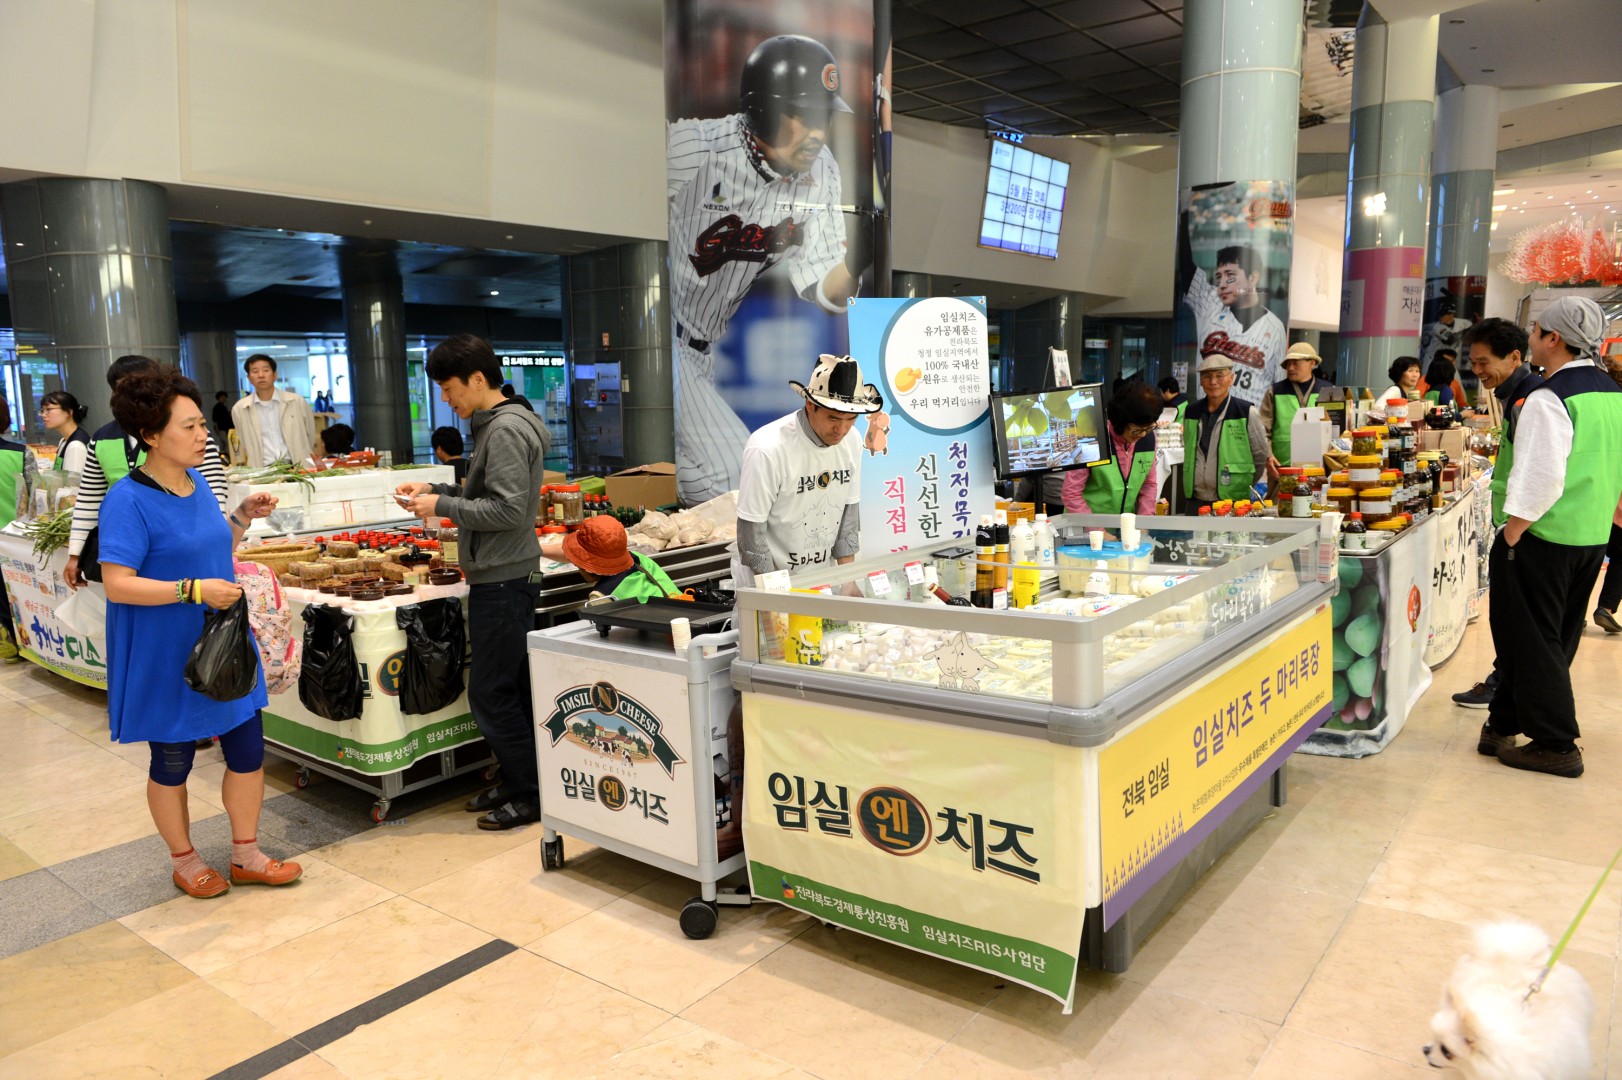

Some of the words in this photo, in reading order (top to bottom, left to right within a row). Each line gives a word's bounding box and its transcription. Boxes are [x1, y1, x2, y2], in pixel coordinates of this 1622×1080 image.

[703, 203, 730, 212] NEXON
[940, 312, 977, 323] 임실치즈
[924, 325, 978, 337] 유가공제품은
[918, 348, 932, 358] 청정
[935, 347, 978, 358] 임실지역에서
[949, 337, 978, 347] 전라북도
[1203, 331, 1266, 369] Giants
[925, 361, 949, 370] 100%
[951, 359, 979, 370] 국내산
[923, 373, 949, 385] 원유로
[951, 374, 980, 384] 생산되는
[958, 384, 980, 394] 안전한
[1234, 369, 1252, 390] 13
[909, 398, 928, 410] 우리
[932, 396, 981, 408] 먹거리입니다
[884, 477, 907, 534] 직접
[915, 454, 942, 539] 신선한
[787, 549, 827, 571] 두마리
[560, 691, 591, 714] IMSIL
[619, 700, 658, 736] CHEESE
[1193, 690, 1254, 769] 임실치즈
[1260, 676, 1272, 715] 두
[1277, 640, 1320, 699] 마리목장
[560, 767, 596, 802] 임실
[629, 786, 669, 825] 치즈
[1122, 776, 1146, 819] 전북
[1148, 758, 1169, 799] 임실
[768, 772, 853, 838] 임실
[934, 806, 1041, 884] 치즈
[795, 885, 909, 934] 전라북도경제통상진흥원
[922, 925, 1048, 973] 임실치즈RIS사업단
